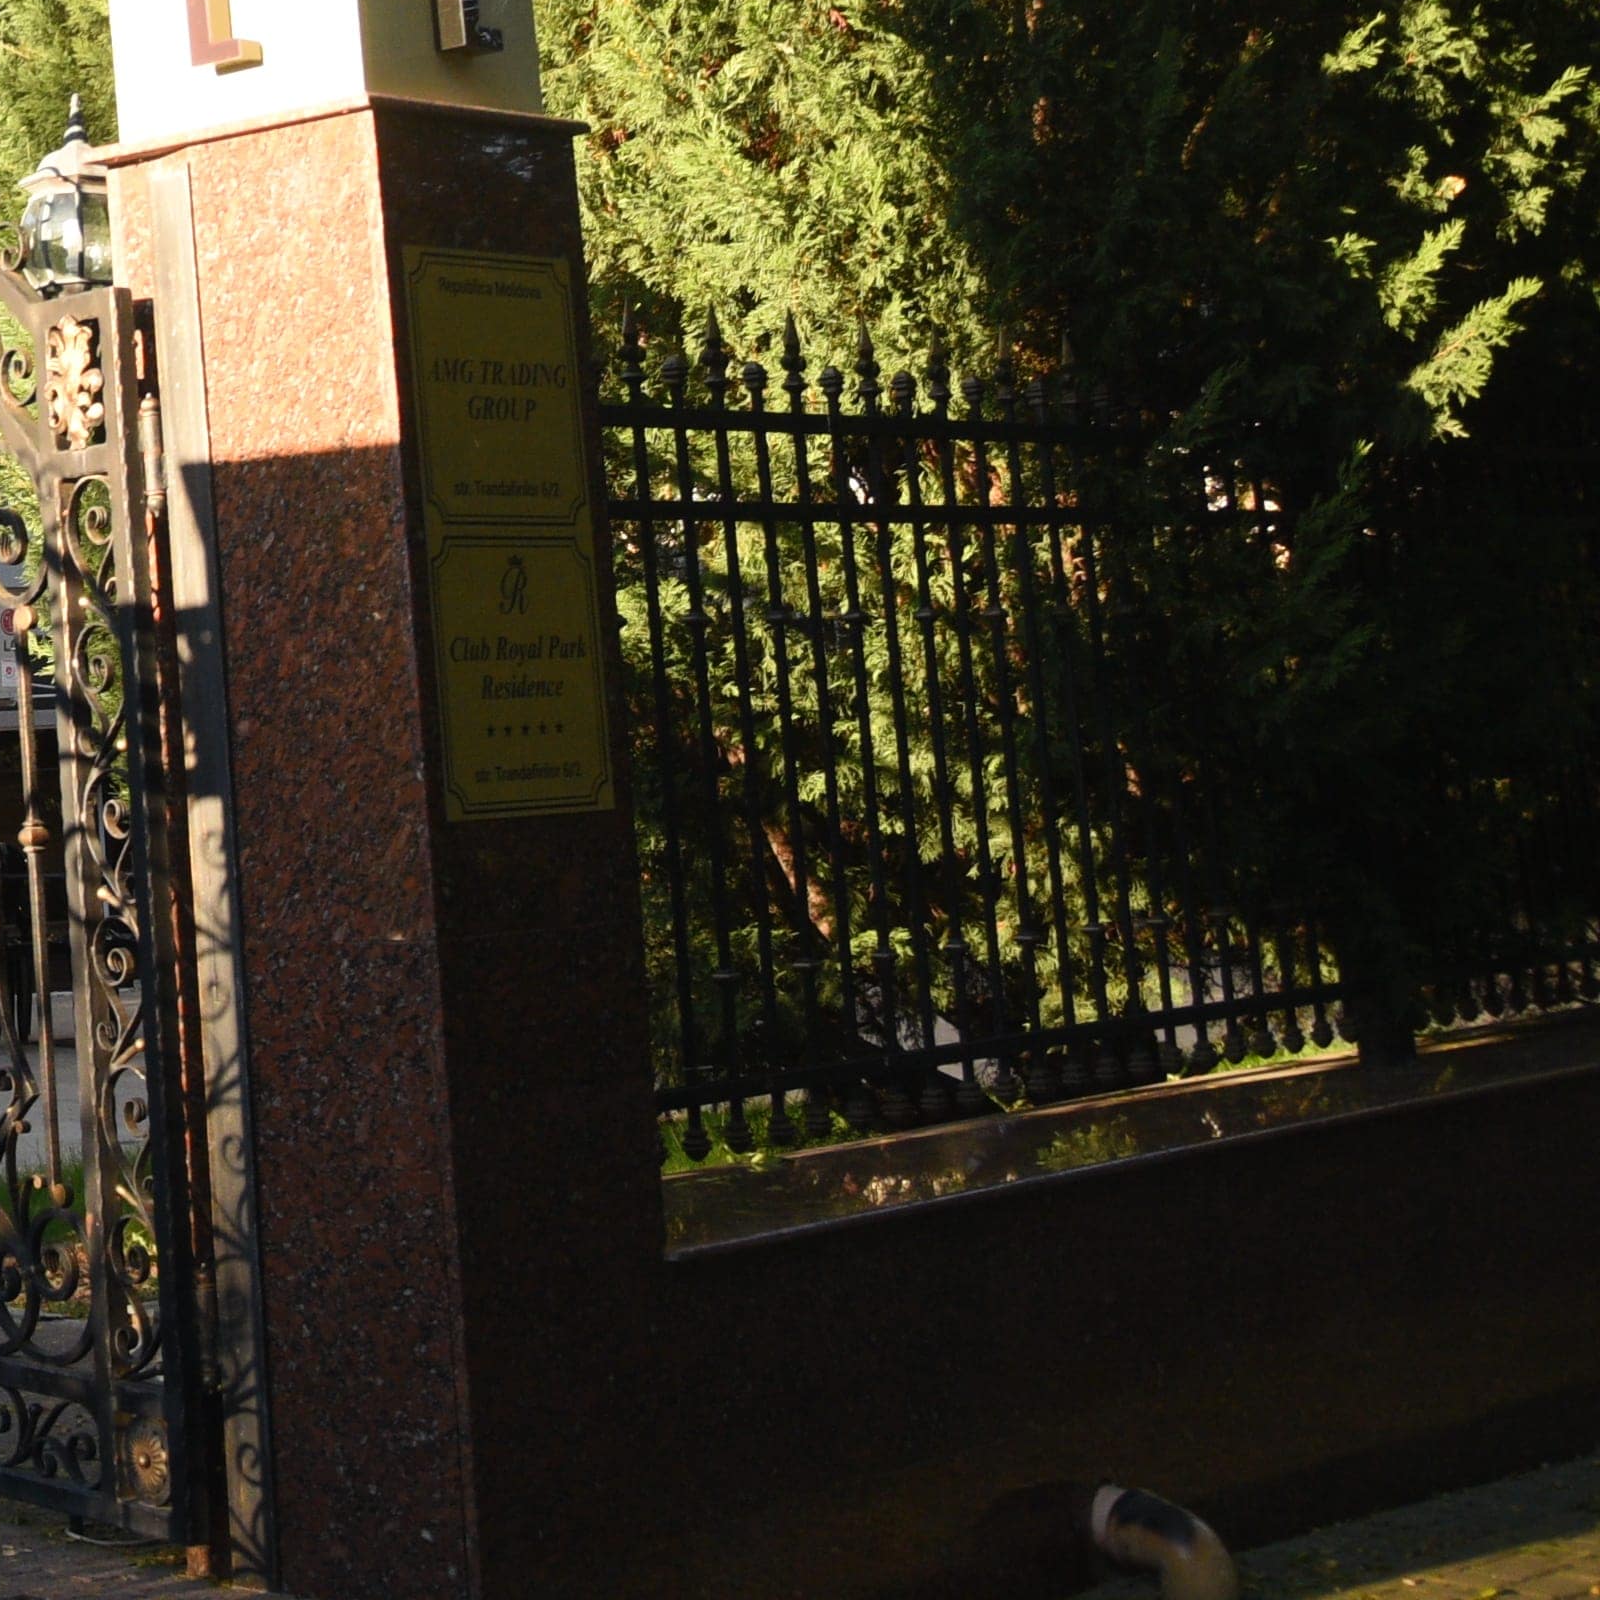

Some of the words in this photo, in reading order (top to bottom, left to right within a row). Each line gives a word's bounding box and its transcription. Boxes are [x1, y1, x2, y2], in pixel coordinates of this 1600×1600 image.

[429, 357, 473, 384] AMG
[479, 360, 568, 389] TRADING
[467, 395, 536, 422] GROUP
[450, 637, 490, 663] Club
[496, 636, 543, 667] Royal
[548, 636, 587, 660] Park
[481, 674, 564, 700] Residence
